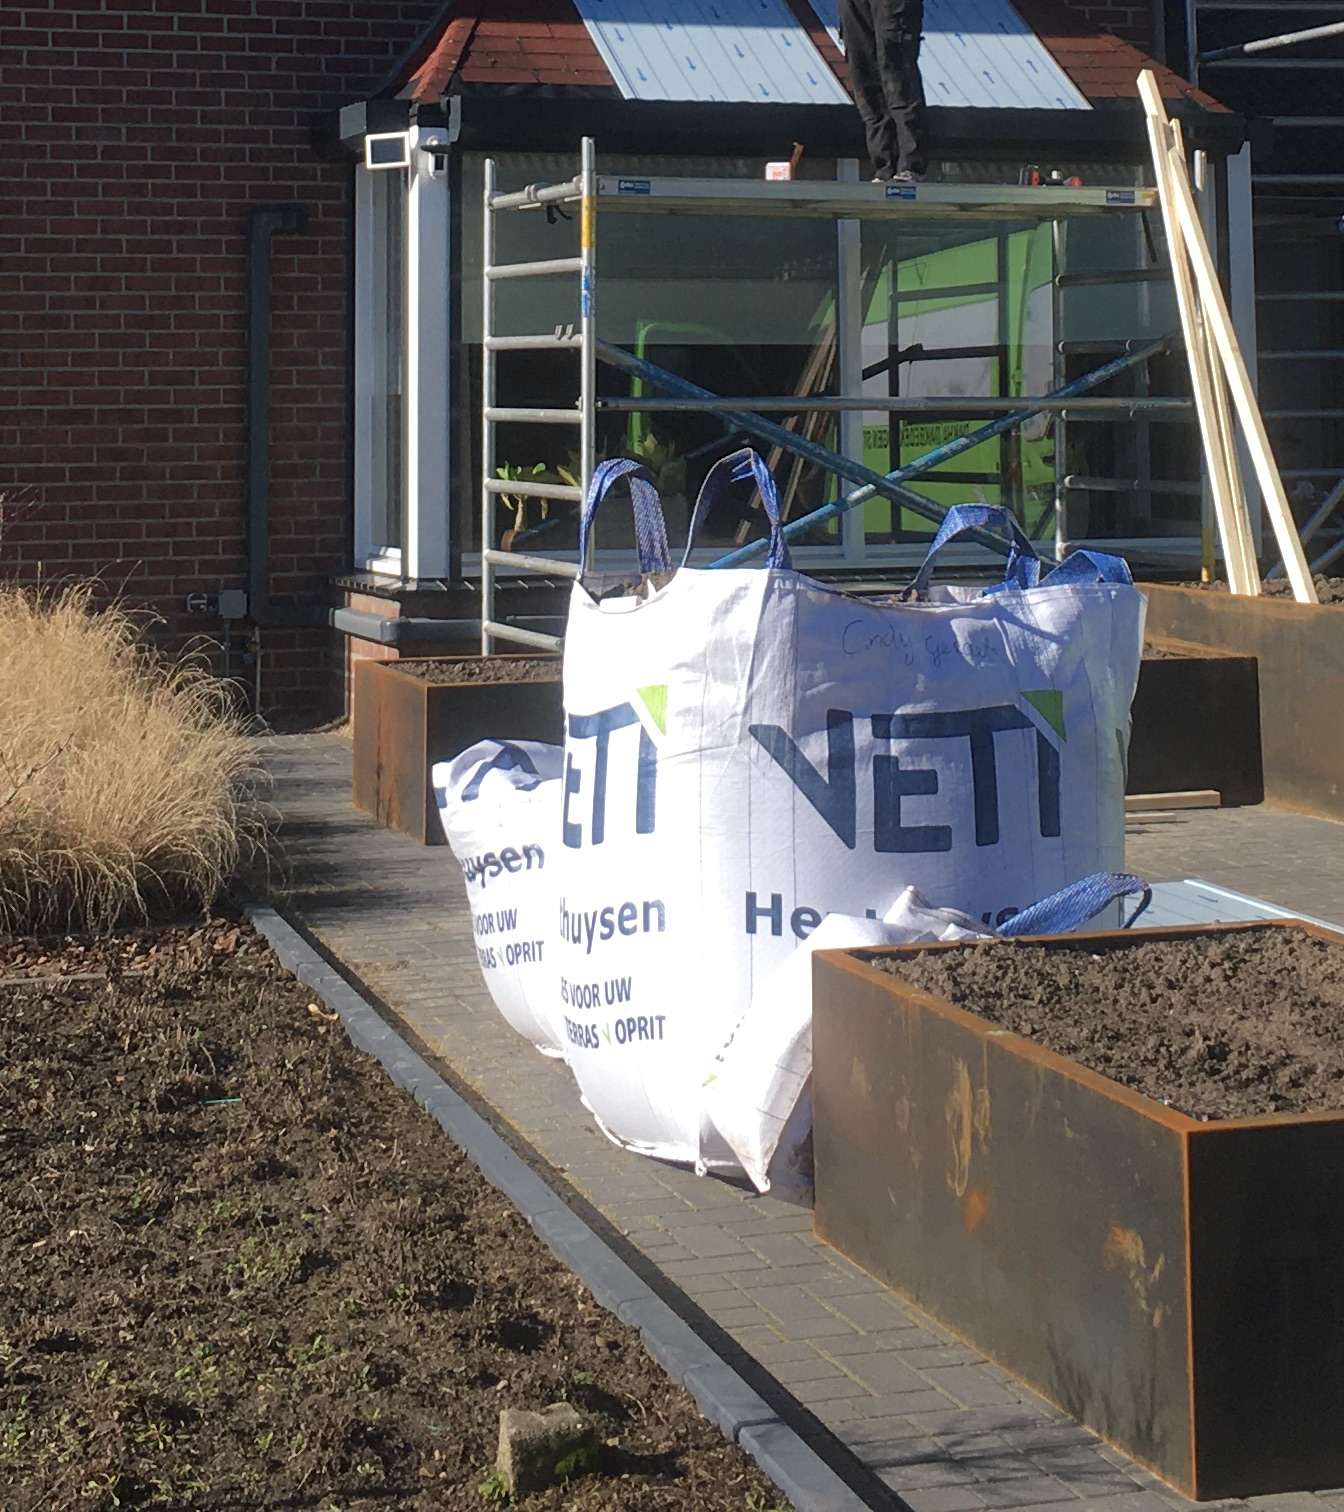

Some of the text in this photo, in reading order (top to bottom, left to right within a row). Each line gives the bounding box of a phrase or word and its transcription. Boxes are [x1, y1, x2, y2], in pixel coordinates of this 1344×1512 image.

[496, 907, 517, 933] UW
[506, 940, 544, 966] OPRIT
[569, 983, 601, 1009] VOOR
[604, 976, 632, 1005] UW
[564, 1015, 666, 1049] TERRAS OPRIT
